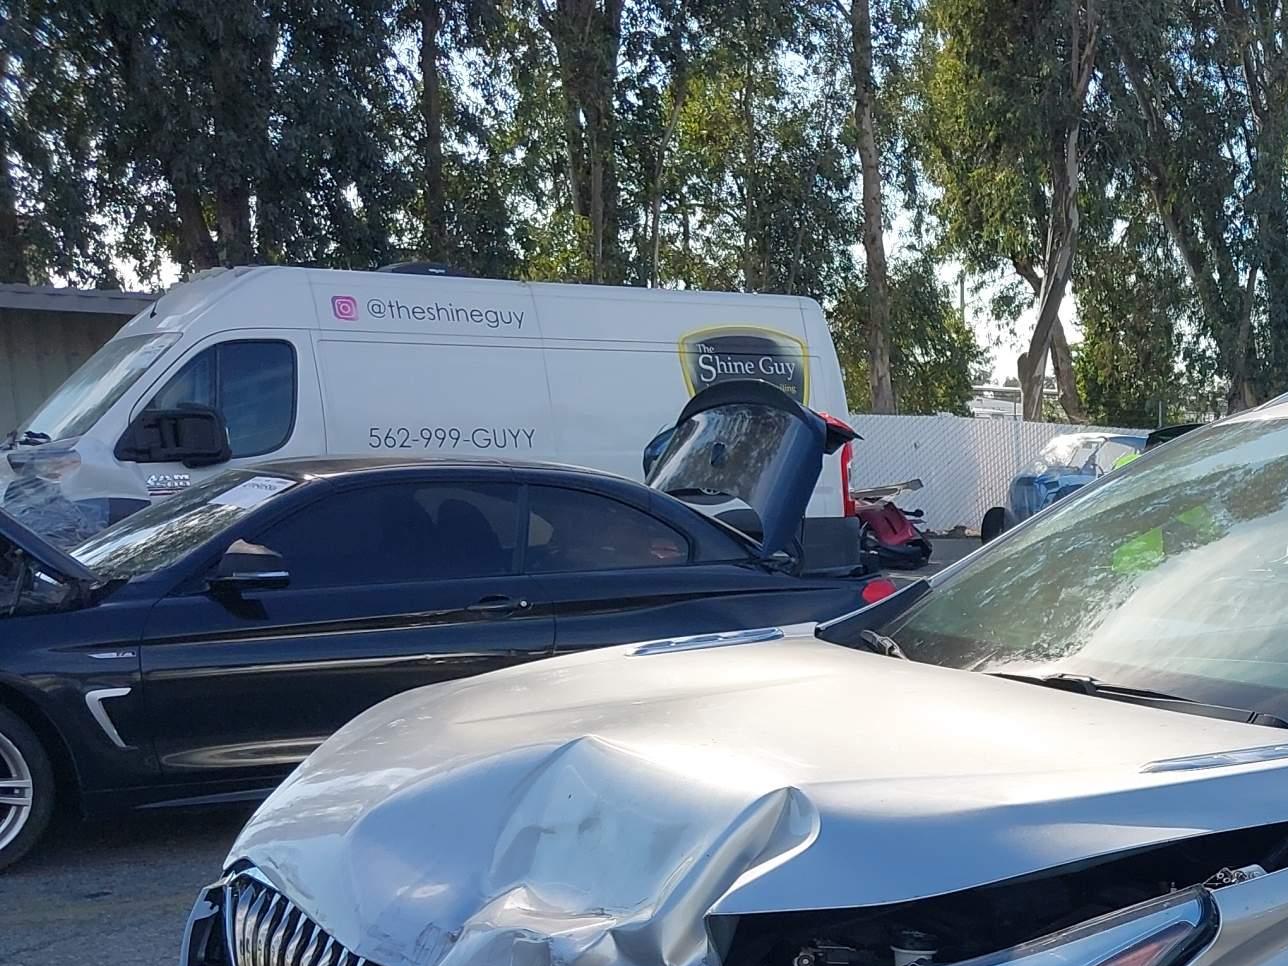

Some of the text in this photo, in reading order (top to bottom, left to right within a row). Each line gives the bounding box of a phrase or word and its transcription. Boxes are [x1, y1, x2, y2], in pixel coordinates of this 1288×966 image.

[367, 299, 524, 329] @theshineguy
[696, 344, 715, 354] The
[699, 354, 796, 382] Shine Guy
[368, 427, 536, 449] 562-999-GUYY
